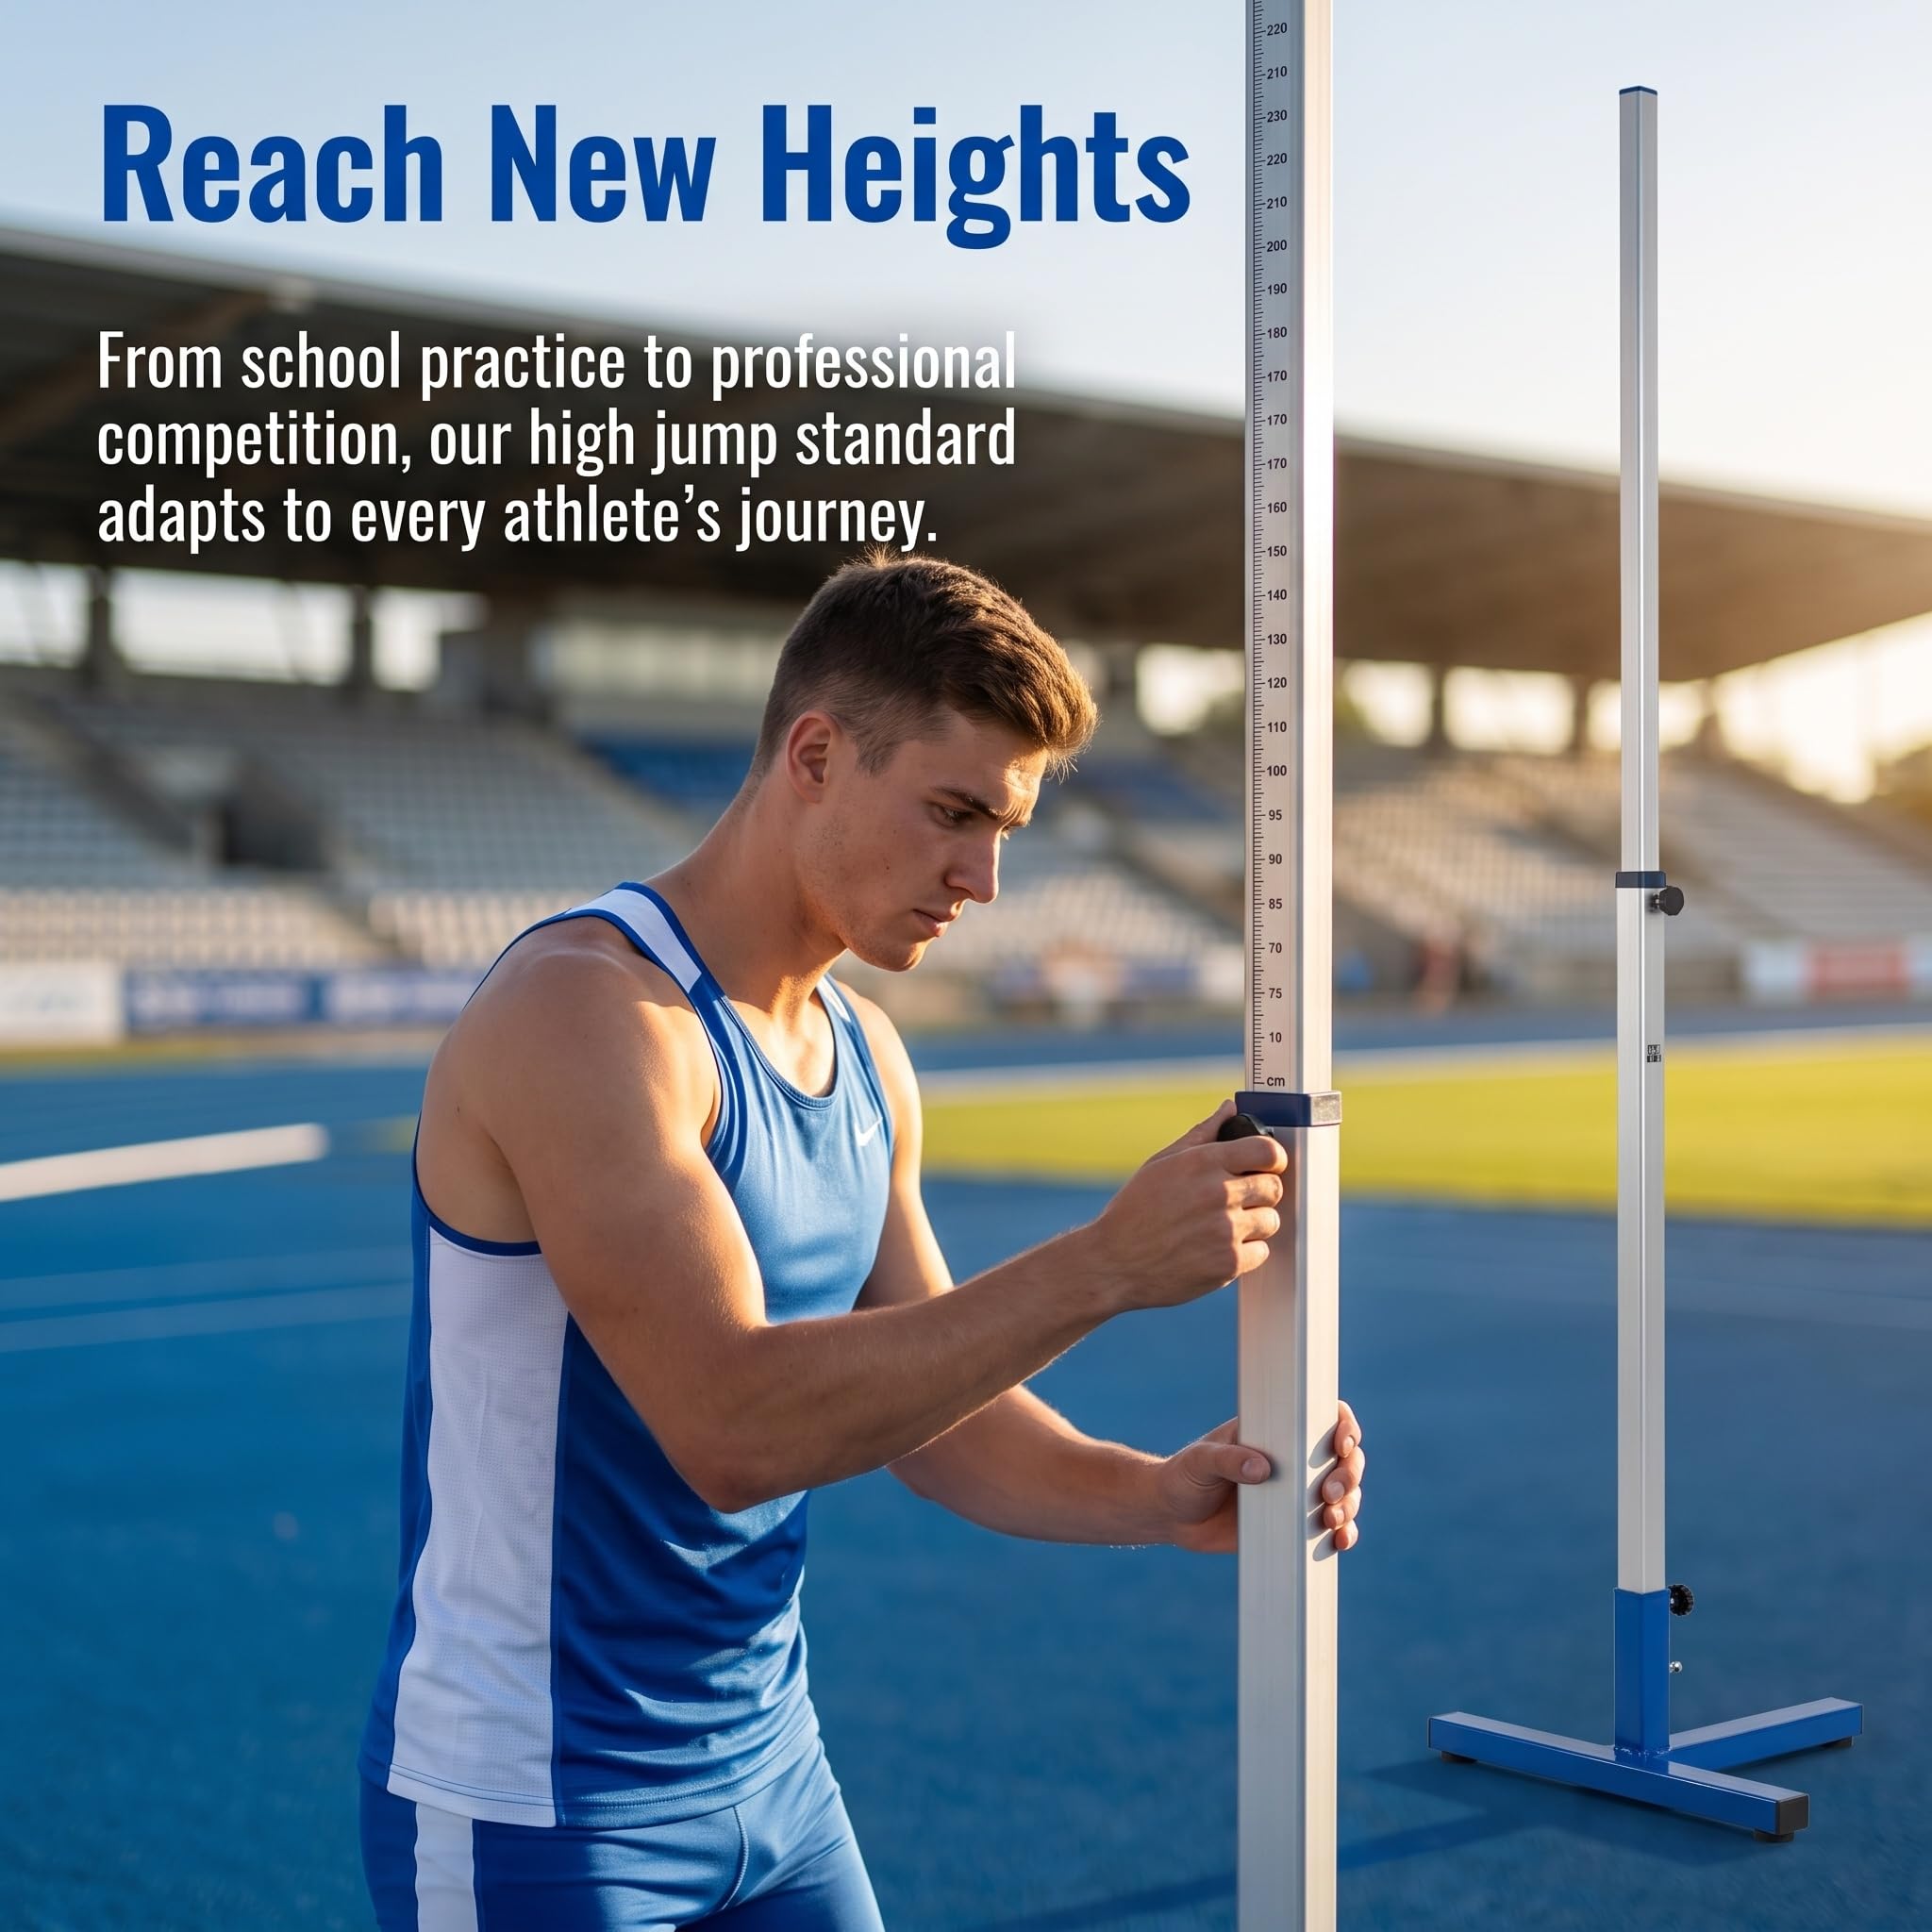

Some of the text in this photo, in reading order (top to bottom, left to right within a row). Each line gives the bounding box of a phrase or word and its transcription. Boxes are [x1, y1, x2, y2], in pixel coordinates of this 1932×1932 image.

[1266, 22, 1288, 37] 220
[1266, 65, 1288, 80] 210
[1266, 108, 1288, 124] 230
[1266, 152, 1288, 167] 220
[1266, 195, 1288, 210] 210
[1266, 239, 1288, 253] 200
[1266, 282, 1288, 295] 190
[1266, 325, 1288, 340] 180
[1266, 369, 1288, 383] 170
[1266, 413, 1288, 426] 170
[1266, 457, 1288, 471] 170
[1266, 501, 1288, 514] 160
[1266, 544, 1288, 558] 150
[1266, 588, 1288, 602] 140
[1266, 632, 1288, 646] 130
[1266, 676, 1288, 690] 120
[1266, 721, 1288, 733] 110
[1266, 764, 1288, 777] 100
[1268, 808, 1283, 822] 95
[1268, 853, 1283, 865] 90
[1268, 897, 1283, 910] 85
[1268, 941, 1283, 955] 70
[1268, 987, 1283, 1000] 75
[1268, 1031, 1283, 1043] 10
[1266, 1076, 1286, 1088] cm
